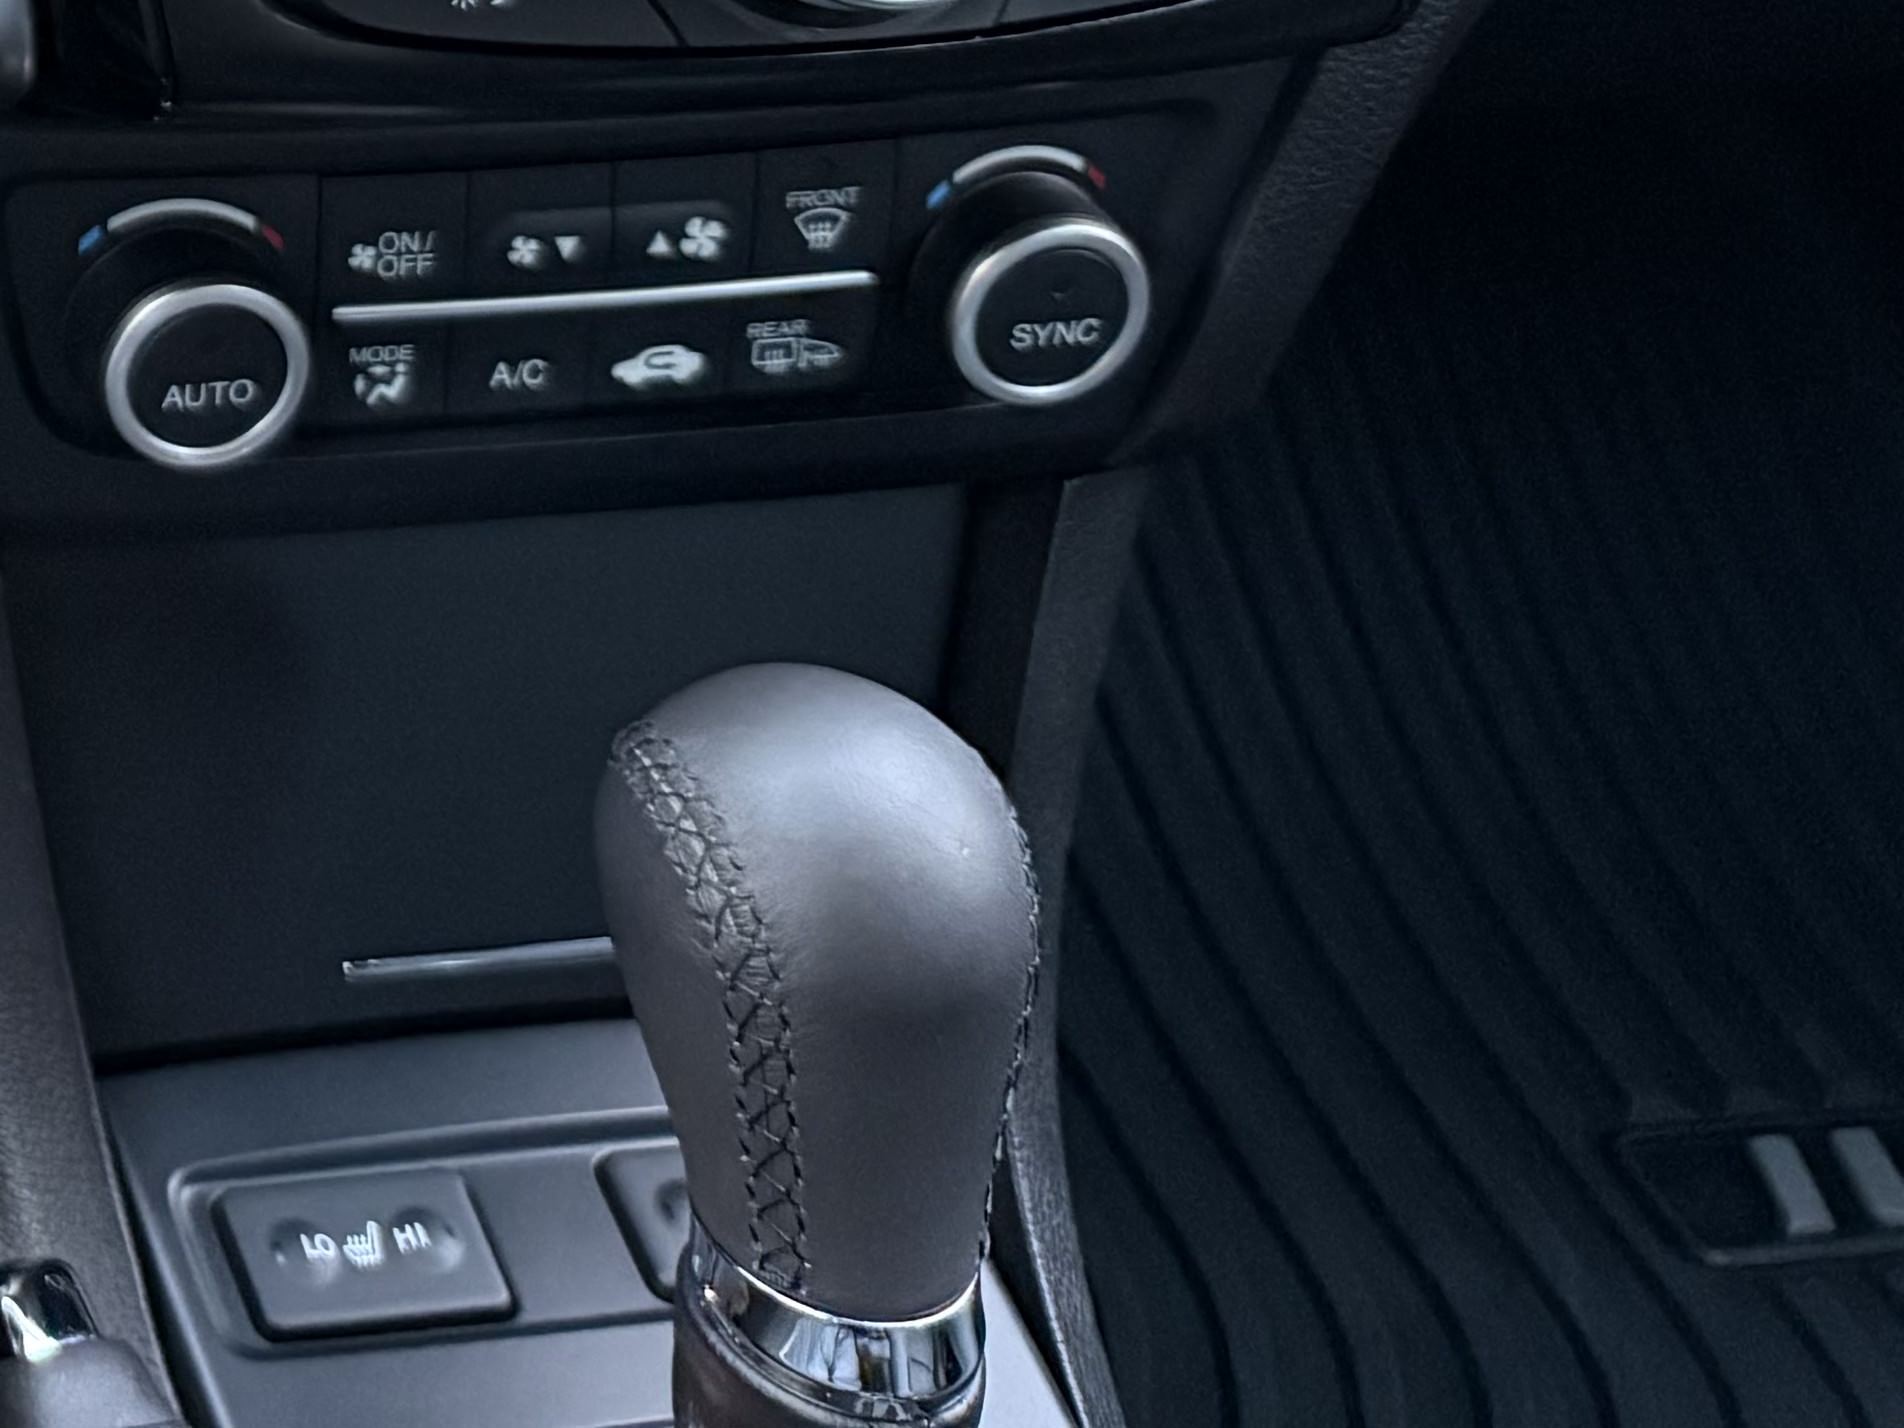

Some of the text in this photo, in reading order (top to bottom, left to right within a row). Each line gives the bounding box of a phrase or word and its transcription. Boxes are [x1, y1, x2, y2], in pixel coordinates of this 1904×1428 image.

[785, 185, 864, 210] FRONT
[377, 230, 440, 256] ON/
[376, 253, 440, 280] OFF
[746, 318, 811, 341] REAR
[1008, 316, 1103, 353] SYNC
[348, 344, 416, 366] MODE
[489, 357, 552, 392] A/C
[160, 377, 259, 413] AUTO
[298, 1232, 339, 1263] LO
[392, 1220, 433, 1255] HI
